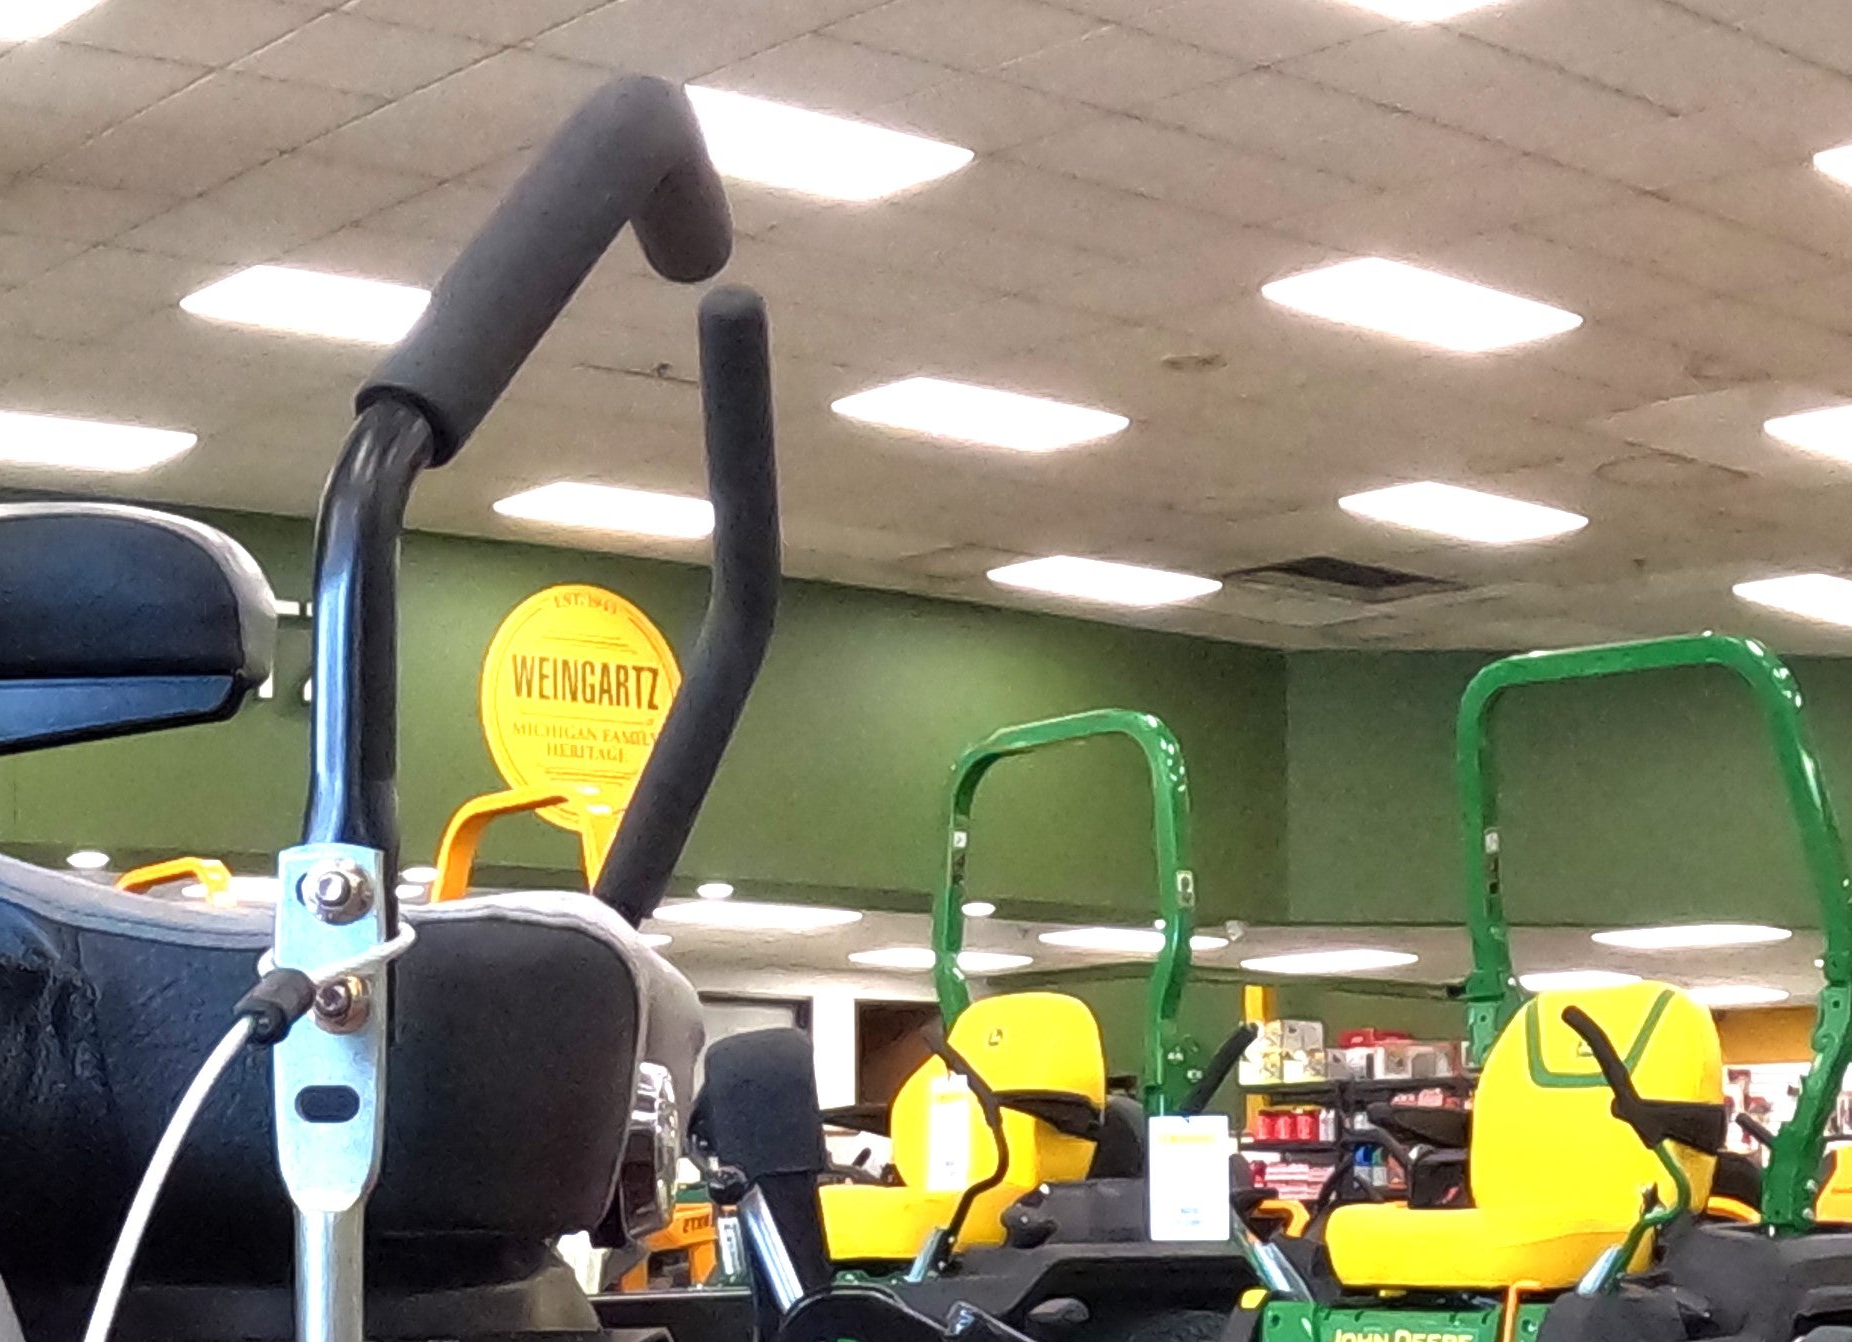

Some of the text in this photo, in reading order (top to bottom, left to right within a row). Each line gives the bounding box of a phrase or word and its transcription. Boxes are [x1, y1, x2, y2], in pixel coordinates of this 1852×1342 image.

[512, 655, 660, 711] WEINGARTZ
[513, 722, 598, 742] MICHIGAN
[546, 742, 624, 763] HERITAGE
